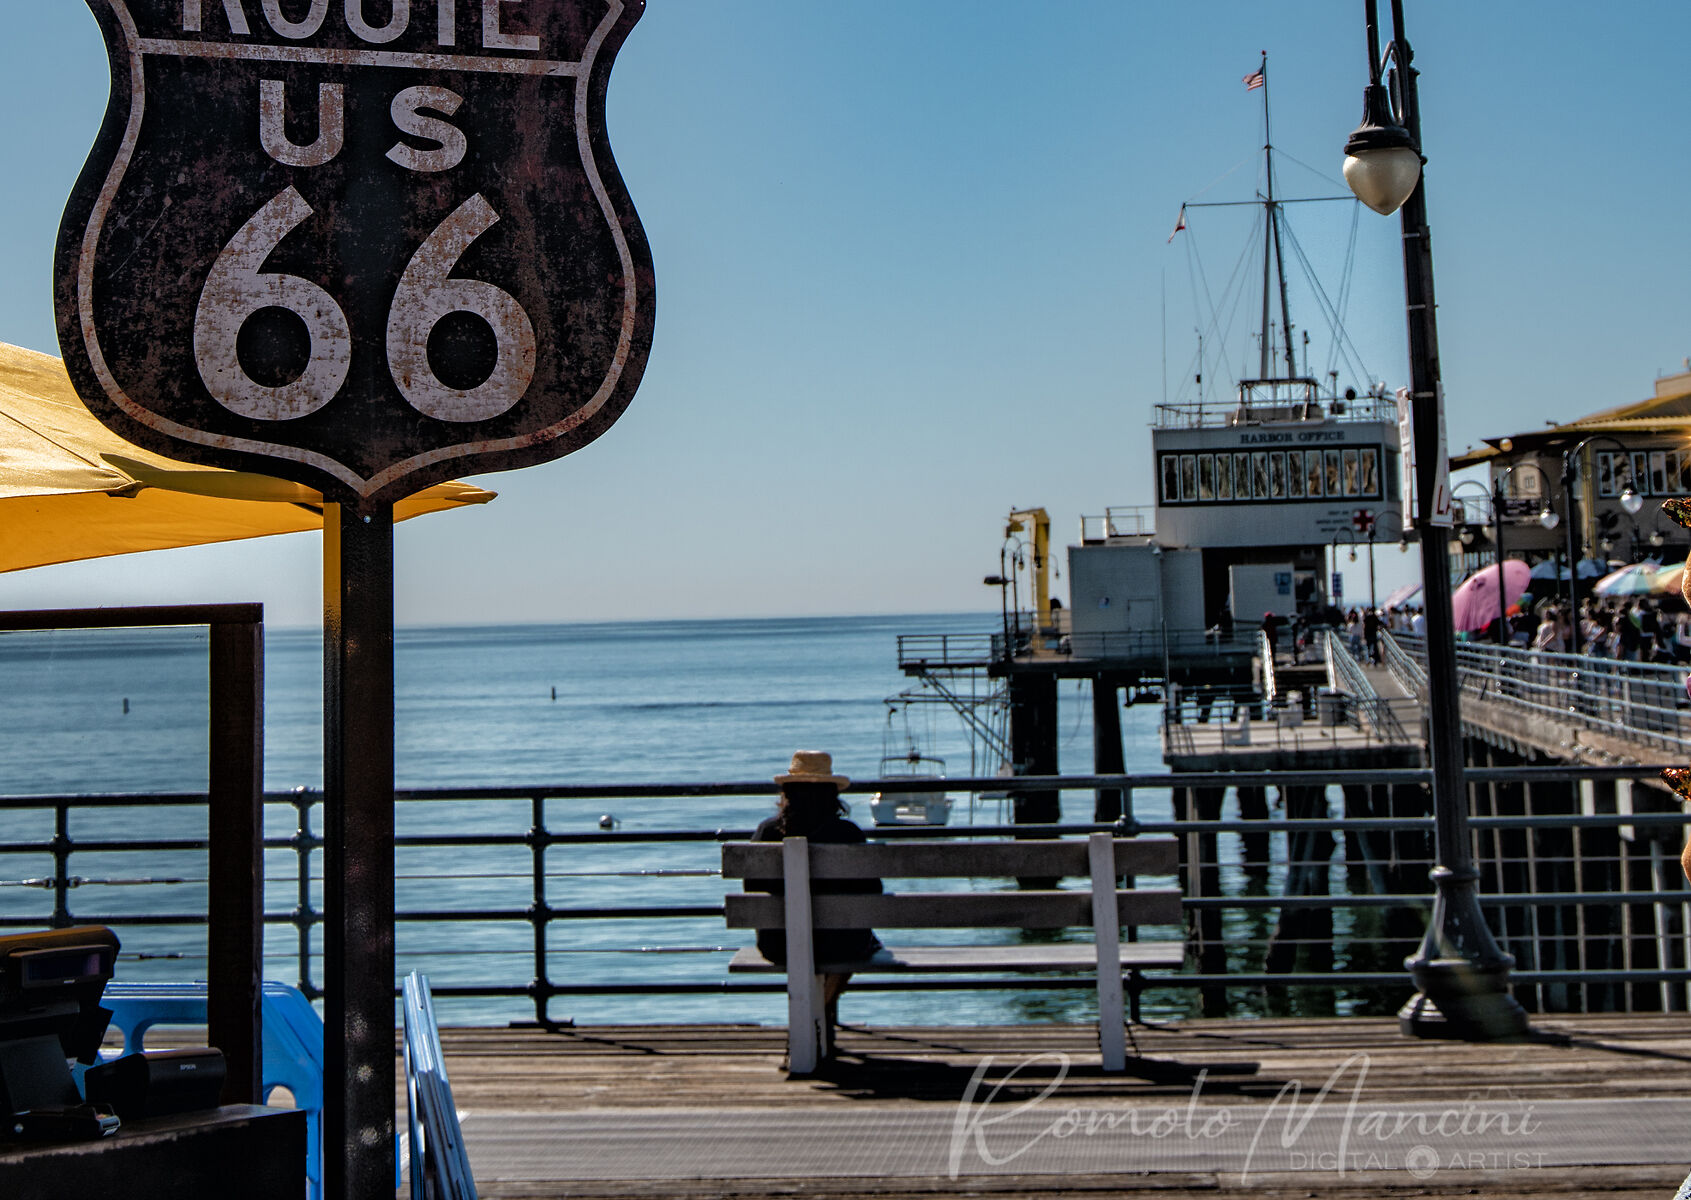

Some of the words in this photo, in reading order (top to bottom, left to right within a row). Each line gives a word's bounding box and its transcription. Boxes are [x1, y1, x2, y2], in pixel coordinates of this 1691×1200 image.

[193, 185, 537, 422] 66
[1240, 432, 1293, 444] HARBOR
[1298, 430, 1345, 442] OFFICE
